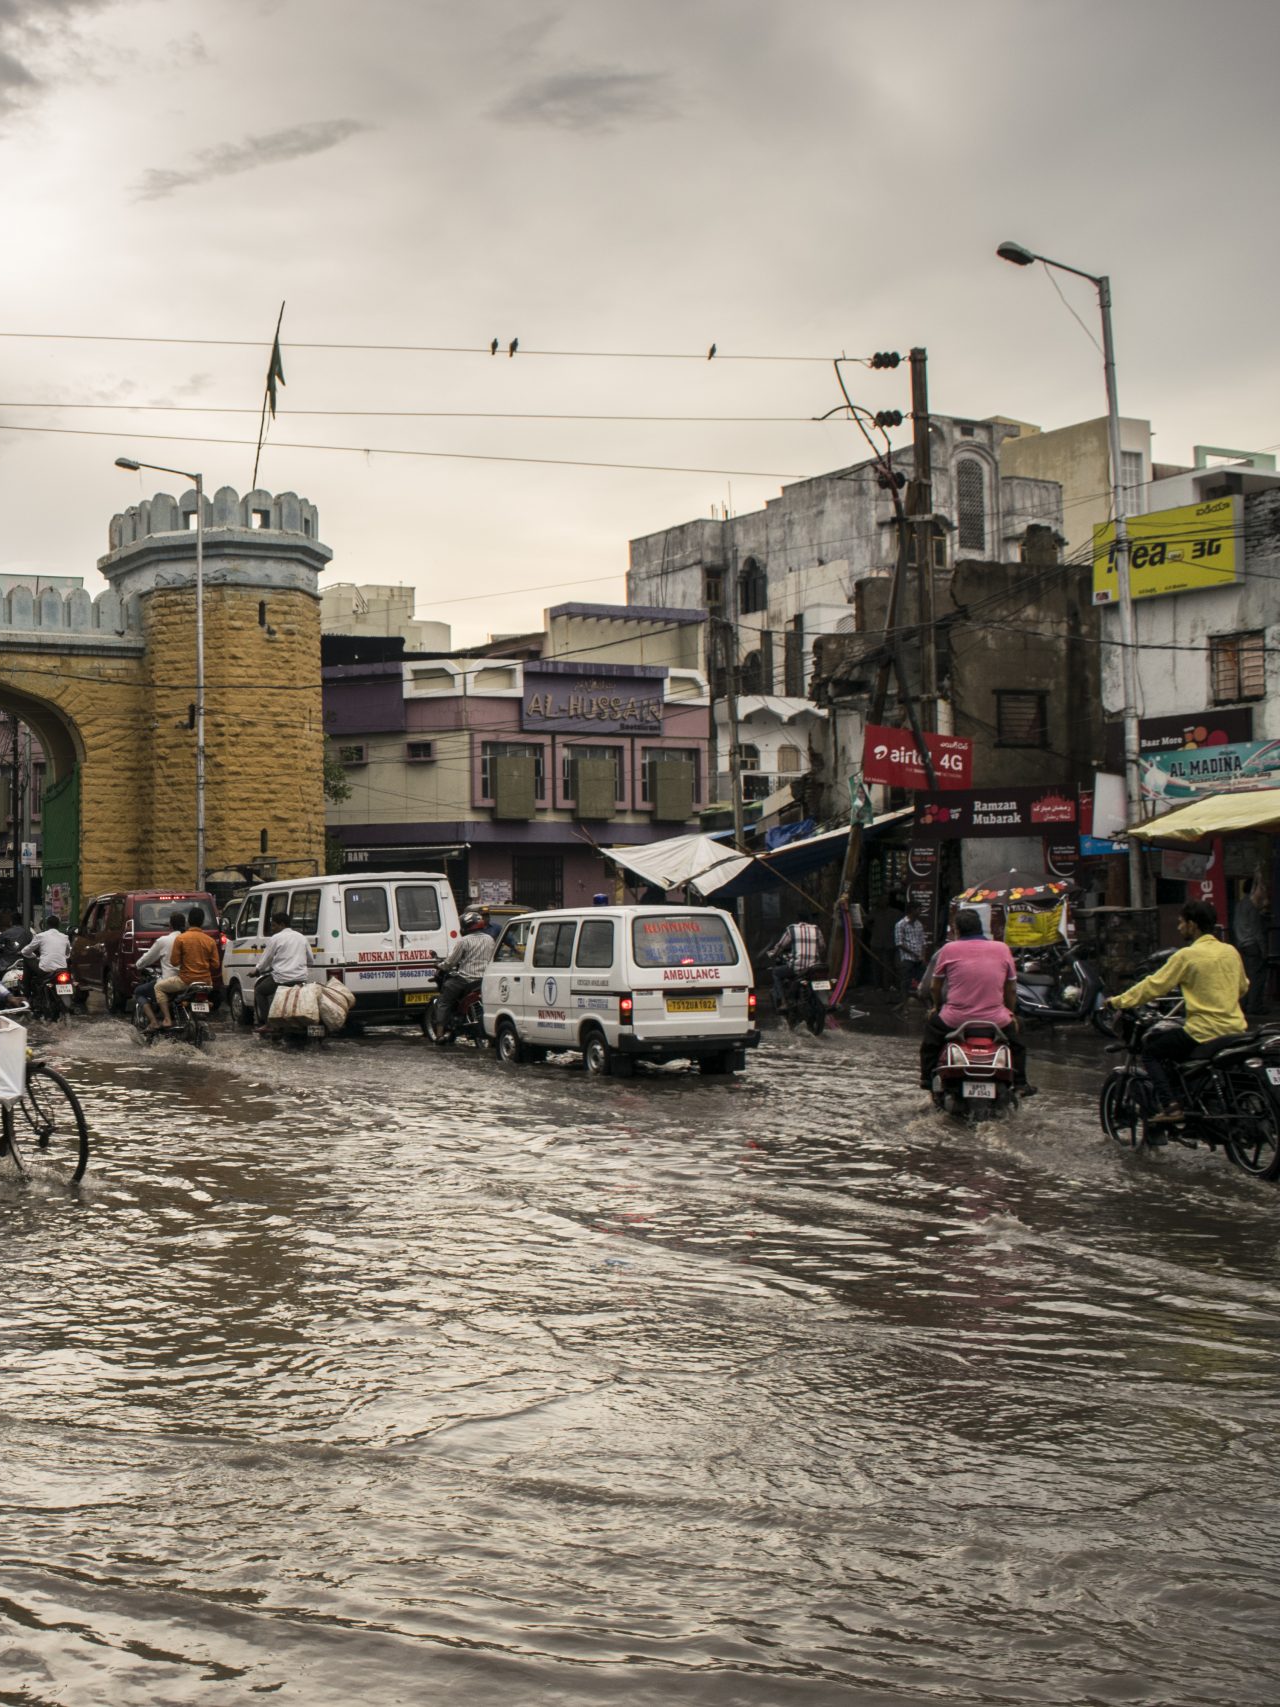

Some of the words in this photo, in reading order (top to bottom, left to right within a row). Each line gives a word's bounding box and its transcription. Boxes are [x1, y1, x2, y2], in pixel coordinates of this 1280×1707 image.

[526, 693, 664, 722] AL-HUSSAIN
[1141, 739, 1160, 747] Baar
[1162, 736, 1183, 745] More
[940, 753, 963, 771] 4G
[1170, 762, 1185, 778] AL
[1190, 755, 1243, 775] MADINA
[974, 801, 1017, 811] Ramzan
[972, 814, 1021, 825] Mubarak
[644, 922, 701, 933] RUNNING
[358, 951, 395, 962] MUSKAN
[398, 950, 433, 961] TRAVELS
[663, 968, 720, 980] AMBULANCE
[538, 1010, 566, 1020] RUNNING
